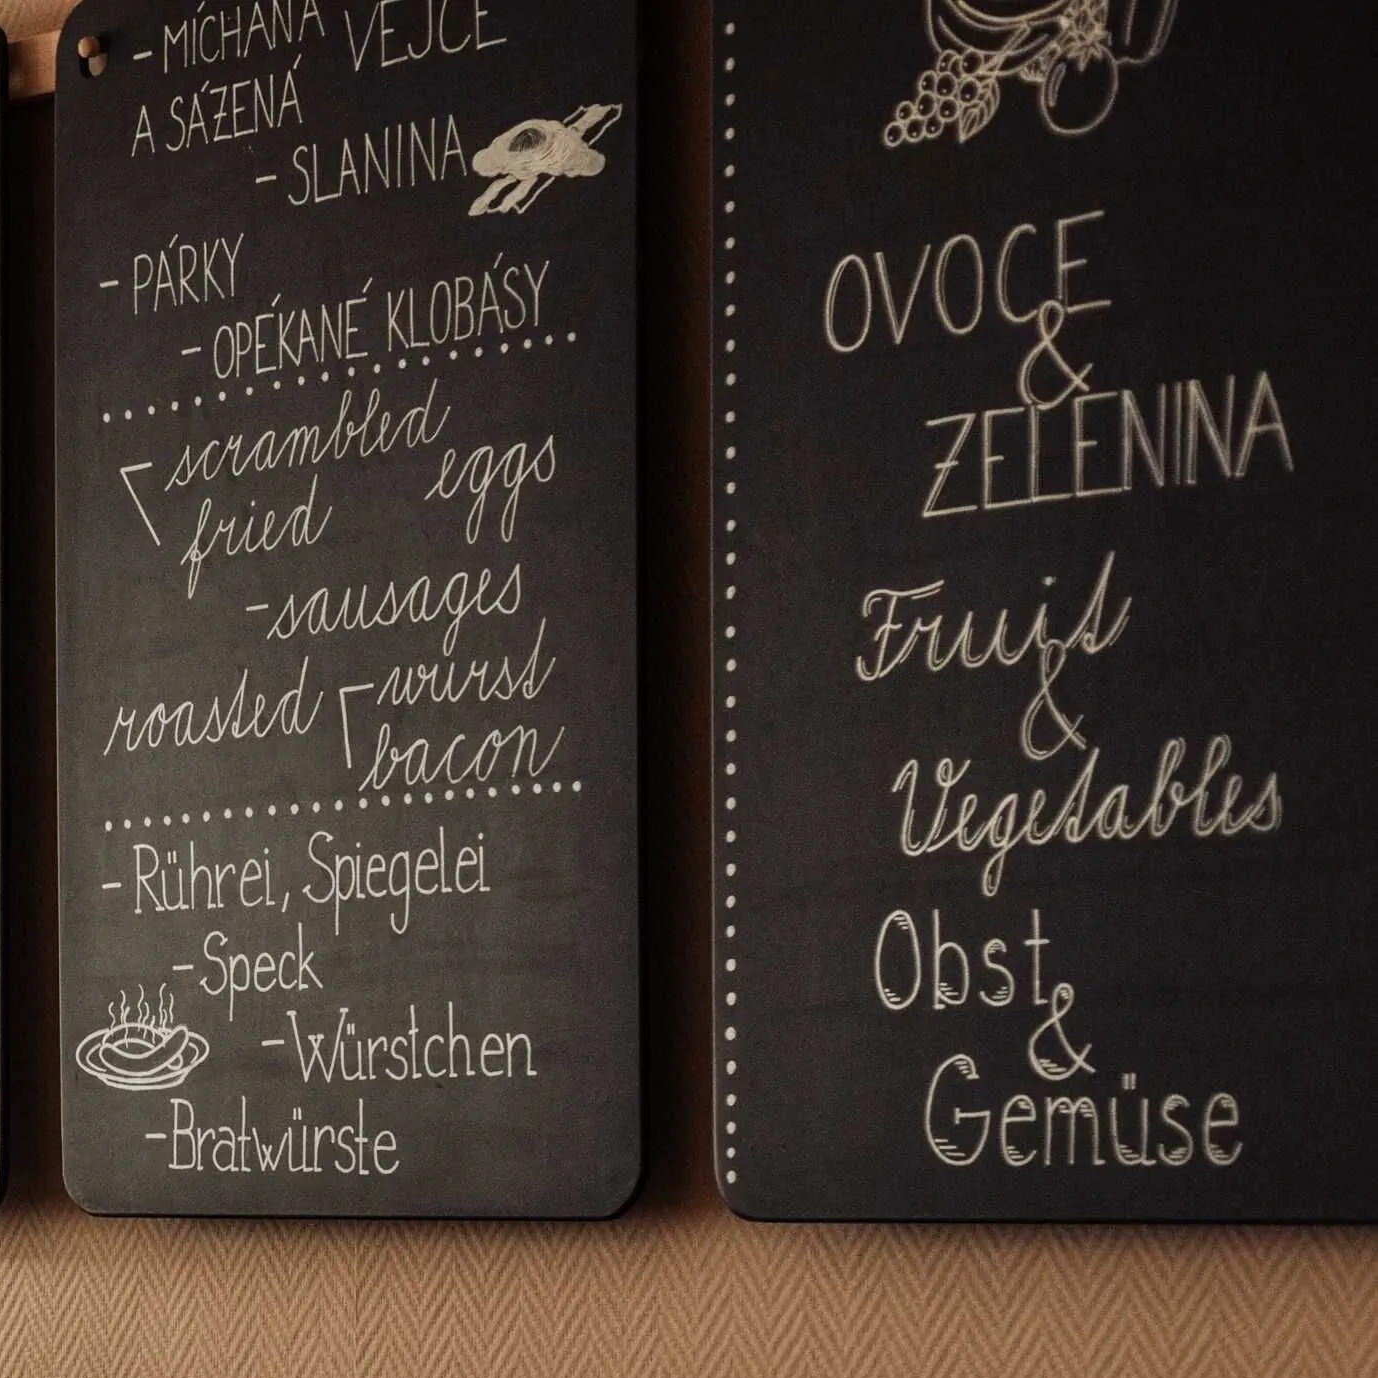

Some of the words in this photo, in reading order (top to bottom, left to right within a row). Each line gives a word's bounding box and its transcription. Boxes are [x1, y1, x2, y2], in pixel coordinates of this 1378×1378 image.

[344, 0, 507, 72] VEJCE
[131, 105, 155, 157] A
[165, 53, 303, 151] SÁZENÁ
[387, 252, 549, 353] KLOBÁSY
[824, 210, 1112, 352] OVOCE
[1017, 299, 1094, 410] &
[164, 379, 450, 491] scrambled
[425, 435, 556, 544] eggs
[922, 370, 1294, 518] ZELENINA
[181, 474, 332, 598] fried
[855, 550, 1132, 681] Fruit
[103, 656, 323, 756] roasted
[1021, 638, 1087, 760] &
[359, 723, 564, 791] bacon
[891, 735, 1283, 896] Vegetables
[301, 826, 491, 936] Spiegelei
[874, 909, 1050, 1010] Obst
[1027, 982, 1097, 1080] &
[924, 1052, 1244, 1167] Gemüse
